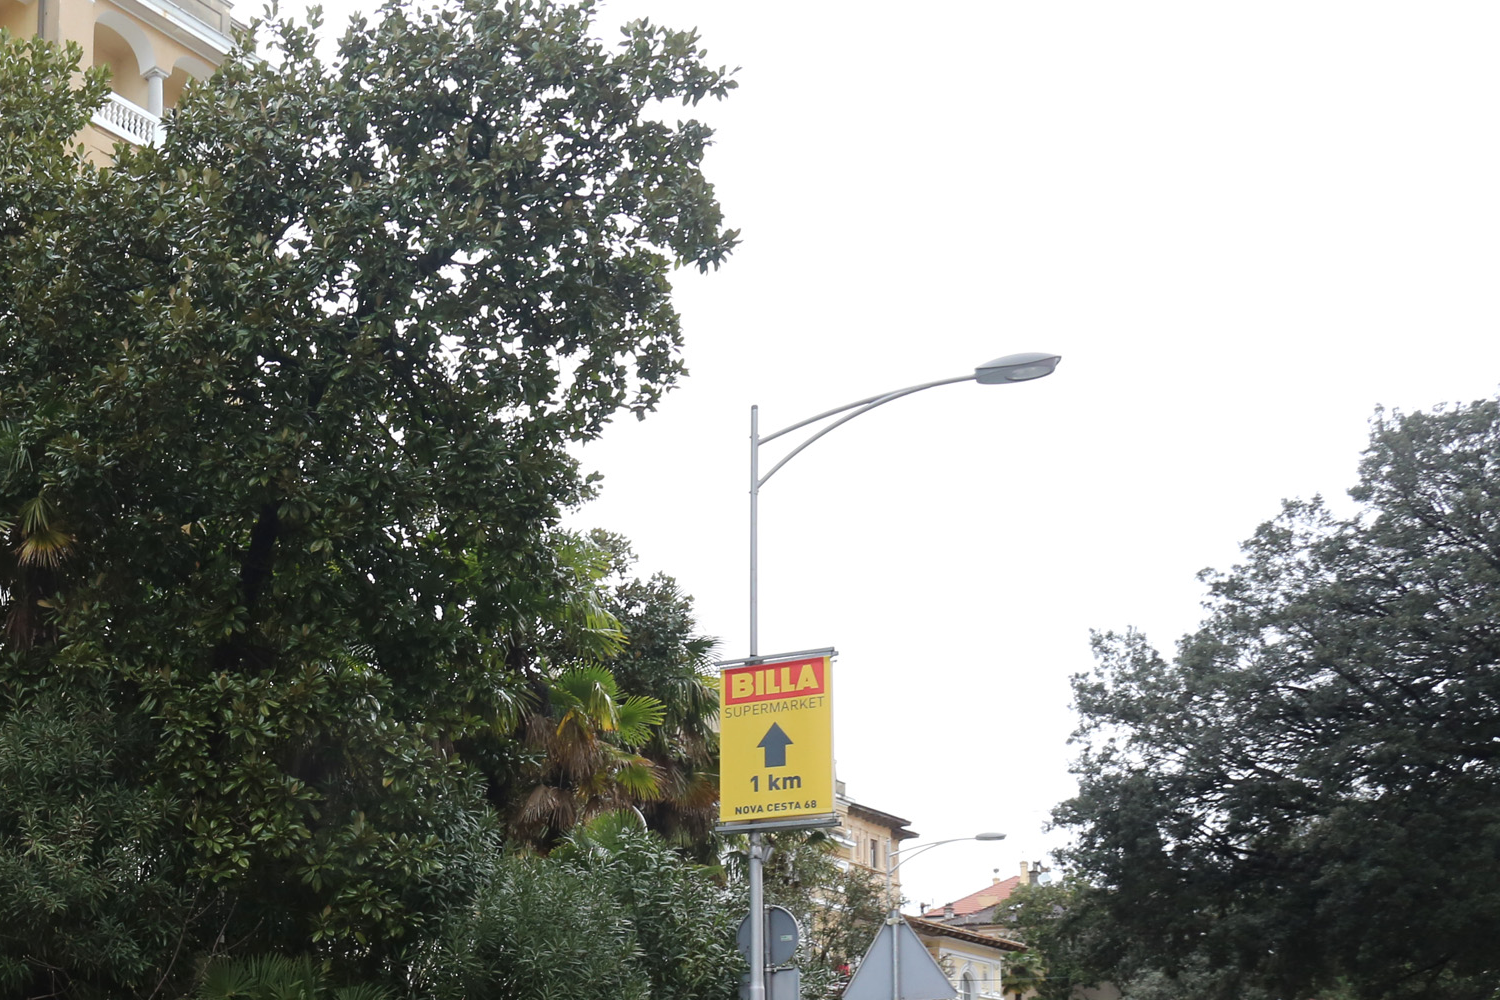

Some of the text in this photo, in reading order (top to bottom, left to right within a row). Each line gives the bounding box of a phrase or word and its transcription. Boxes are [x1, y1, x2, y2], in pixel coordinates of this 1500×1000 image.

[732, 664, 819, 698] BILLA
[724, 696, 824, 718] SUPERMARKET
[750, 774, 802, 792] 1 km
[735, 800, 817, 815] NOVA CESTA 68
